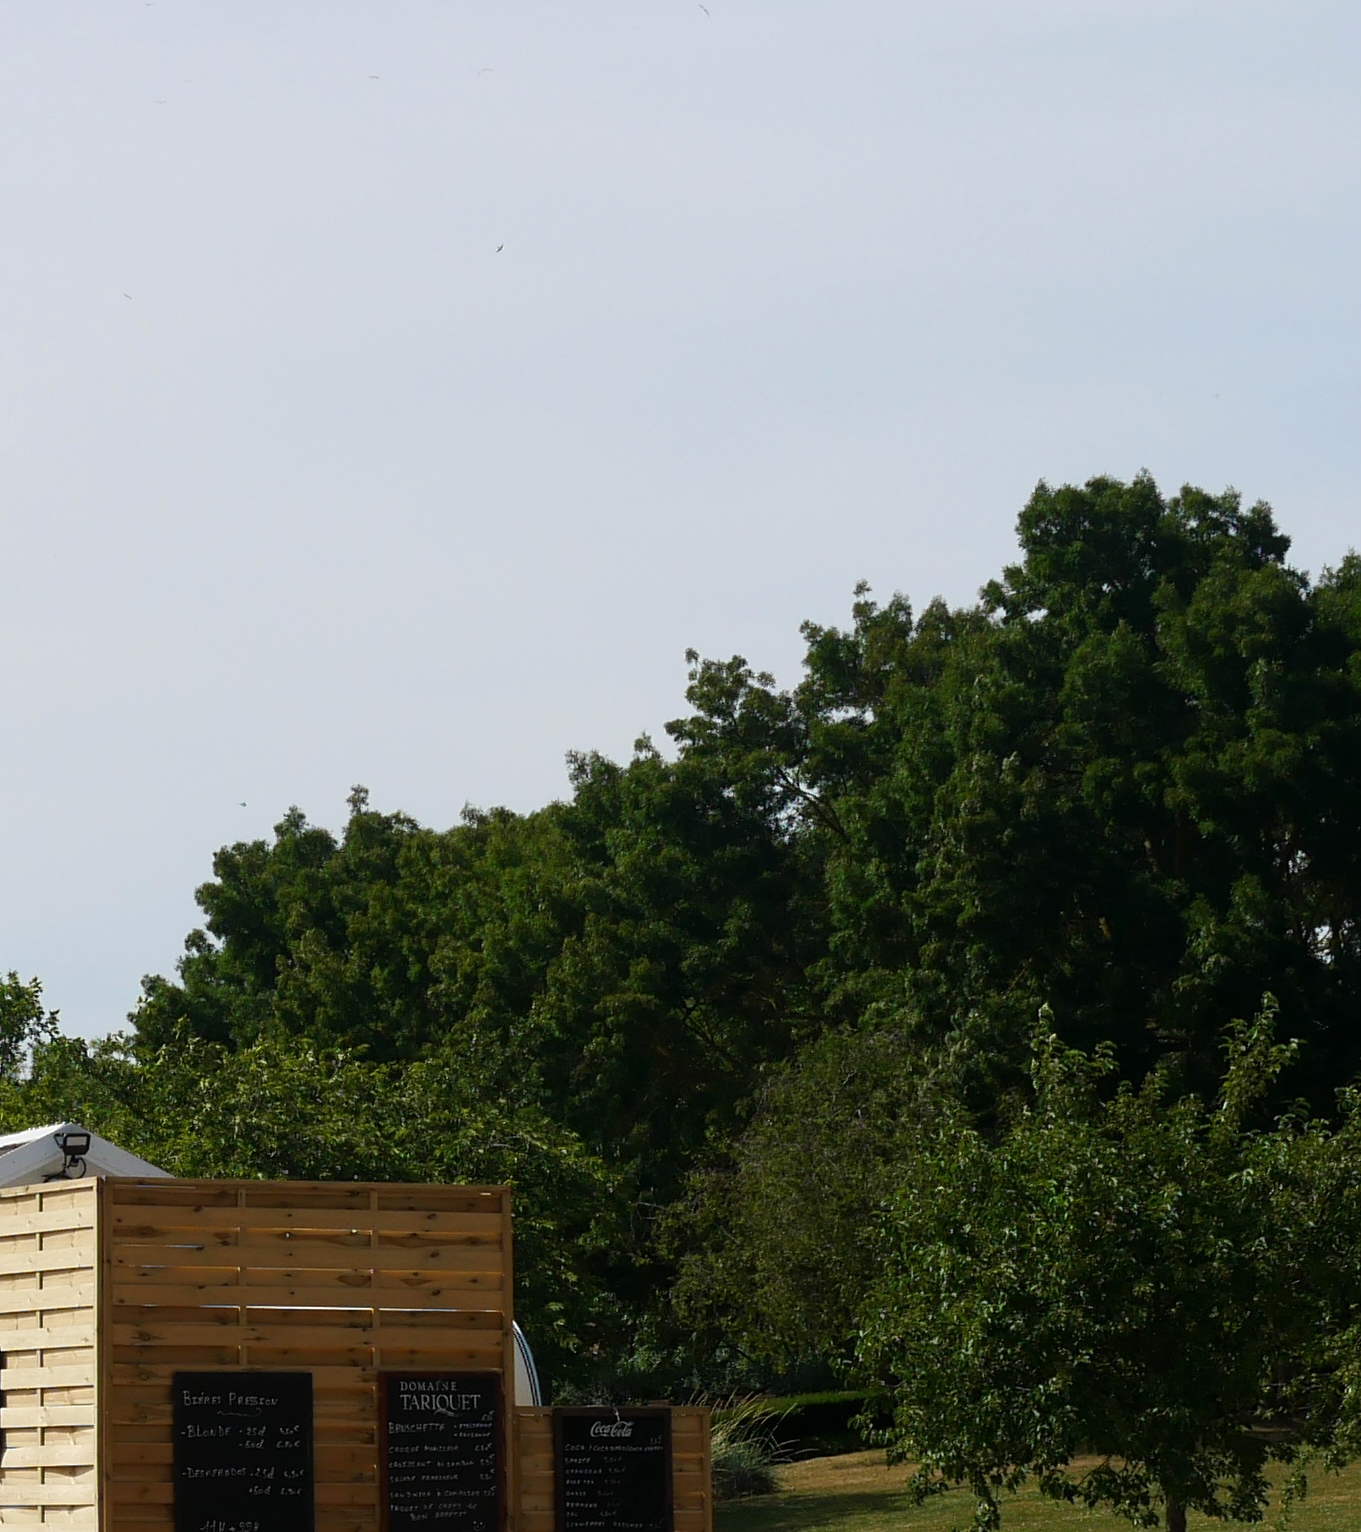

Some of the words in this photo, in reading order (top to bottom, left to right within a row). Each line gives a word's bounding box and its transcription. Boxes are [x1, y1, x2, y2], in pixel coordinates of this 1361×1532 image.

[399, 1381, 458, 1392] DOMAINE
[228, 1392, 279, 1406] PRESSION
[399, 1394, 482, 1416] TARIQUET
[388, 1421, 445, 1434] BRUSCHETTA
